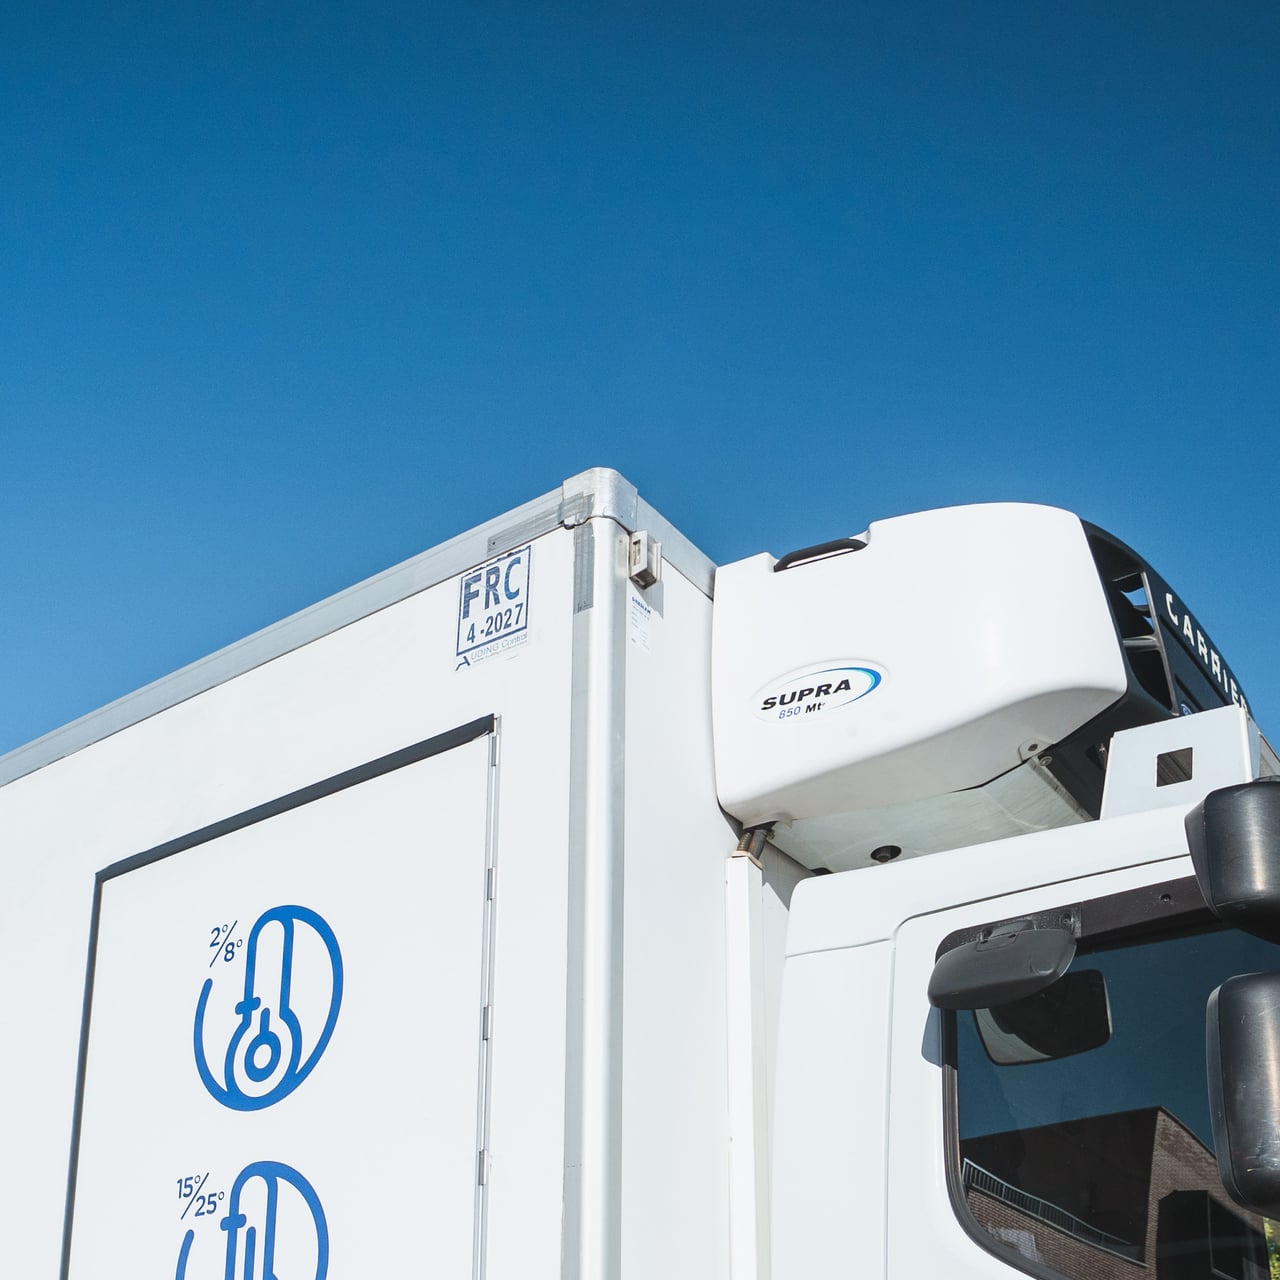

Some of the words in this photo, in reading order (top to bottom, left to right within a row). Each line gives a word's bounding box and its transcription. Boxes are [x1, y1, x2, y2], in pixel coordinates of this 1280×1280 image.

[462, 556, 521, 619] FRC
[761, 679, 851, 711] SUPRA
[779, 706, 801, 719] 850
